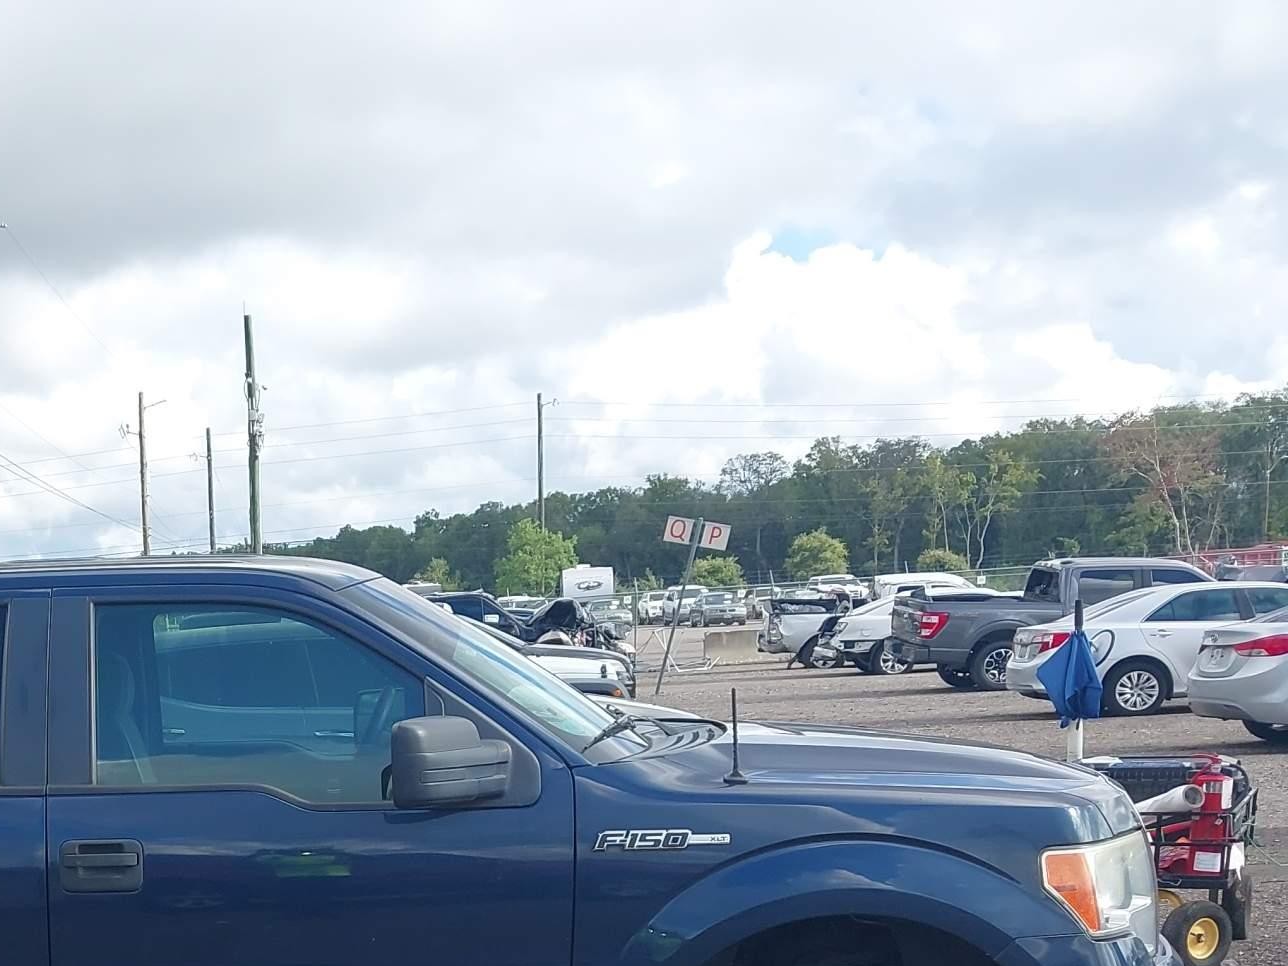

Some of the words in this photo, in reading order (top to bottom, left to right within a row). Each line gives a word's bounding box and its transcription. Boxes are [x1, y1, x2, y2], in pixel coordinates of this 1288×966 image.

[671, 520, 685, 541] Q
[709, 527, 722, 544] P
[594, 829, 691, 850] F-150
